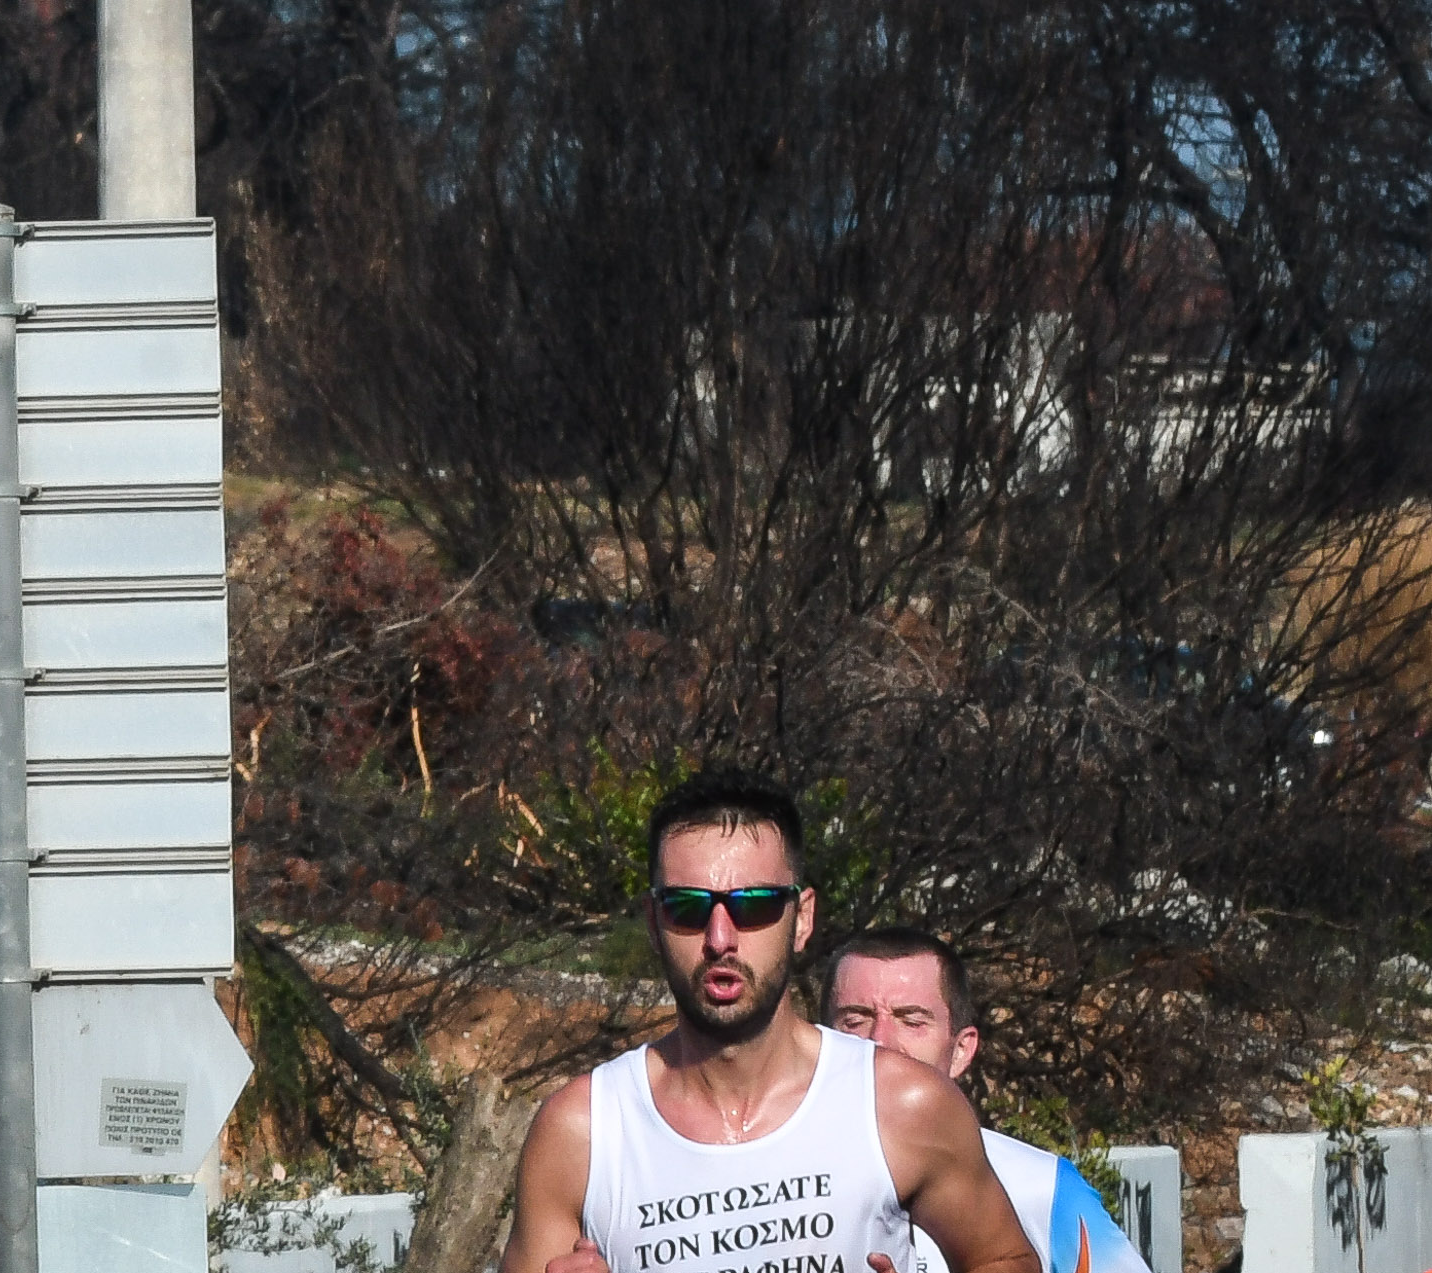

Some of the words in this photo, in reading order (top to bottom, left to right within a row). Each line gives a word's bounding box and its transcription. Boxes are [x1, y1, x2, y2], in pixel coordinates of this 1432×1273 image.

[637, 1173, 832, 1230] ΣΚΟΤΩΣΑΤΕ
[634, 1233, 702, 1270] ΤΟΝ
[711, 1212, 835, 1256] ΚΟΣΜΟ
